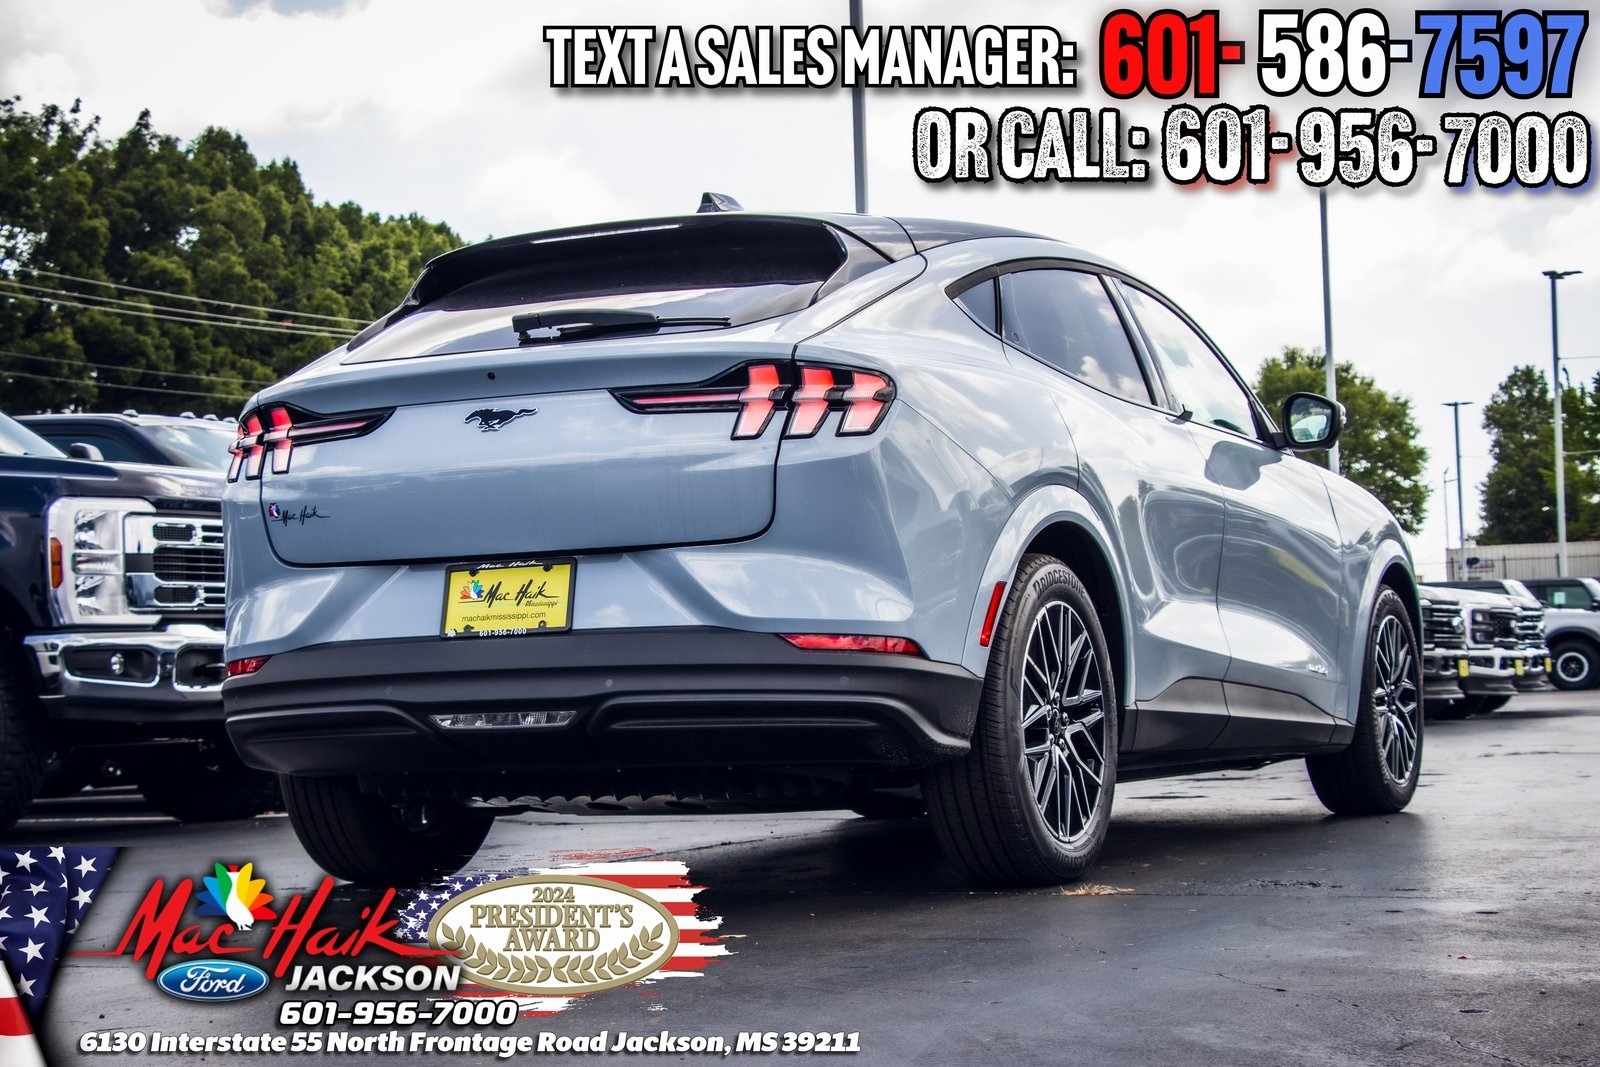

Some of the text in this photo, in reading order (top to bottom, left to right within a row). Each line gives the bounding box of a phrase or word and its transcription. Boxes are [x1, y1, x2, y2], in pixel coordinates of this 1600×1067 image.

[276, 505, 330, 527] Mac Haik
[478, 579, 559, 608] Mac Haik
[1033, 569, 1086, 600] BRIDGESTONE
[462, 611, 546, 622] machaikmississippi.com
[479, 628, 527, 637] 601-956-7000
